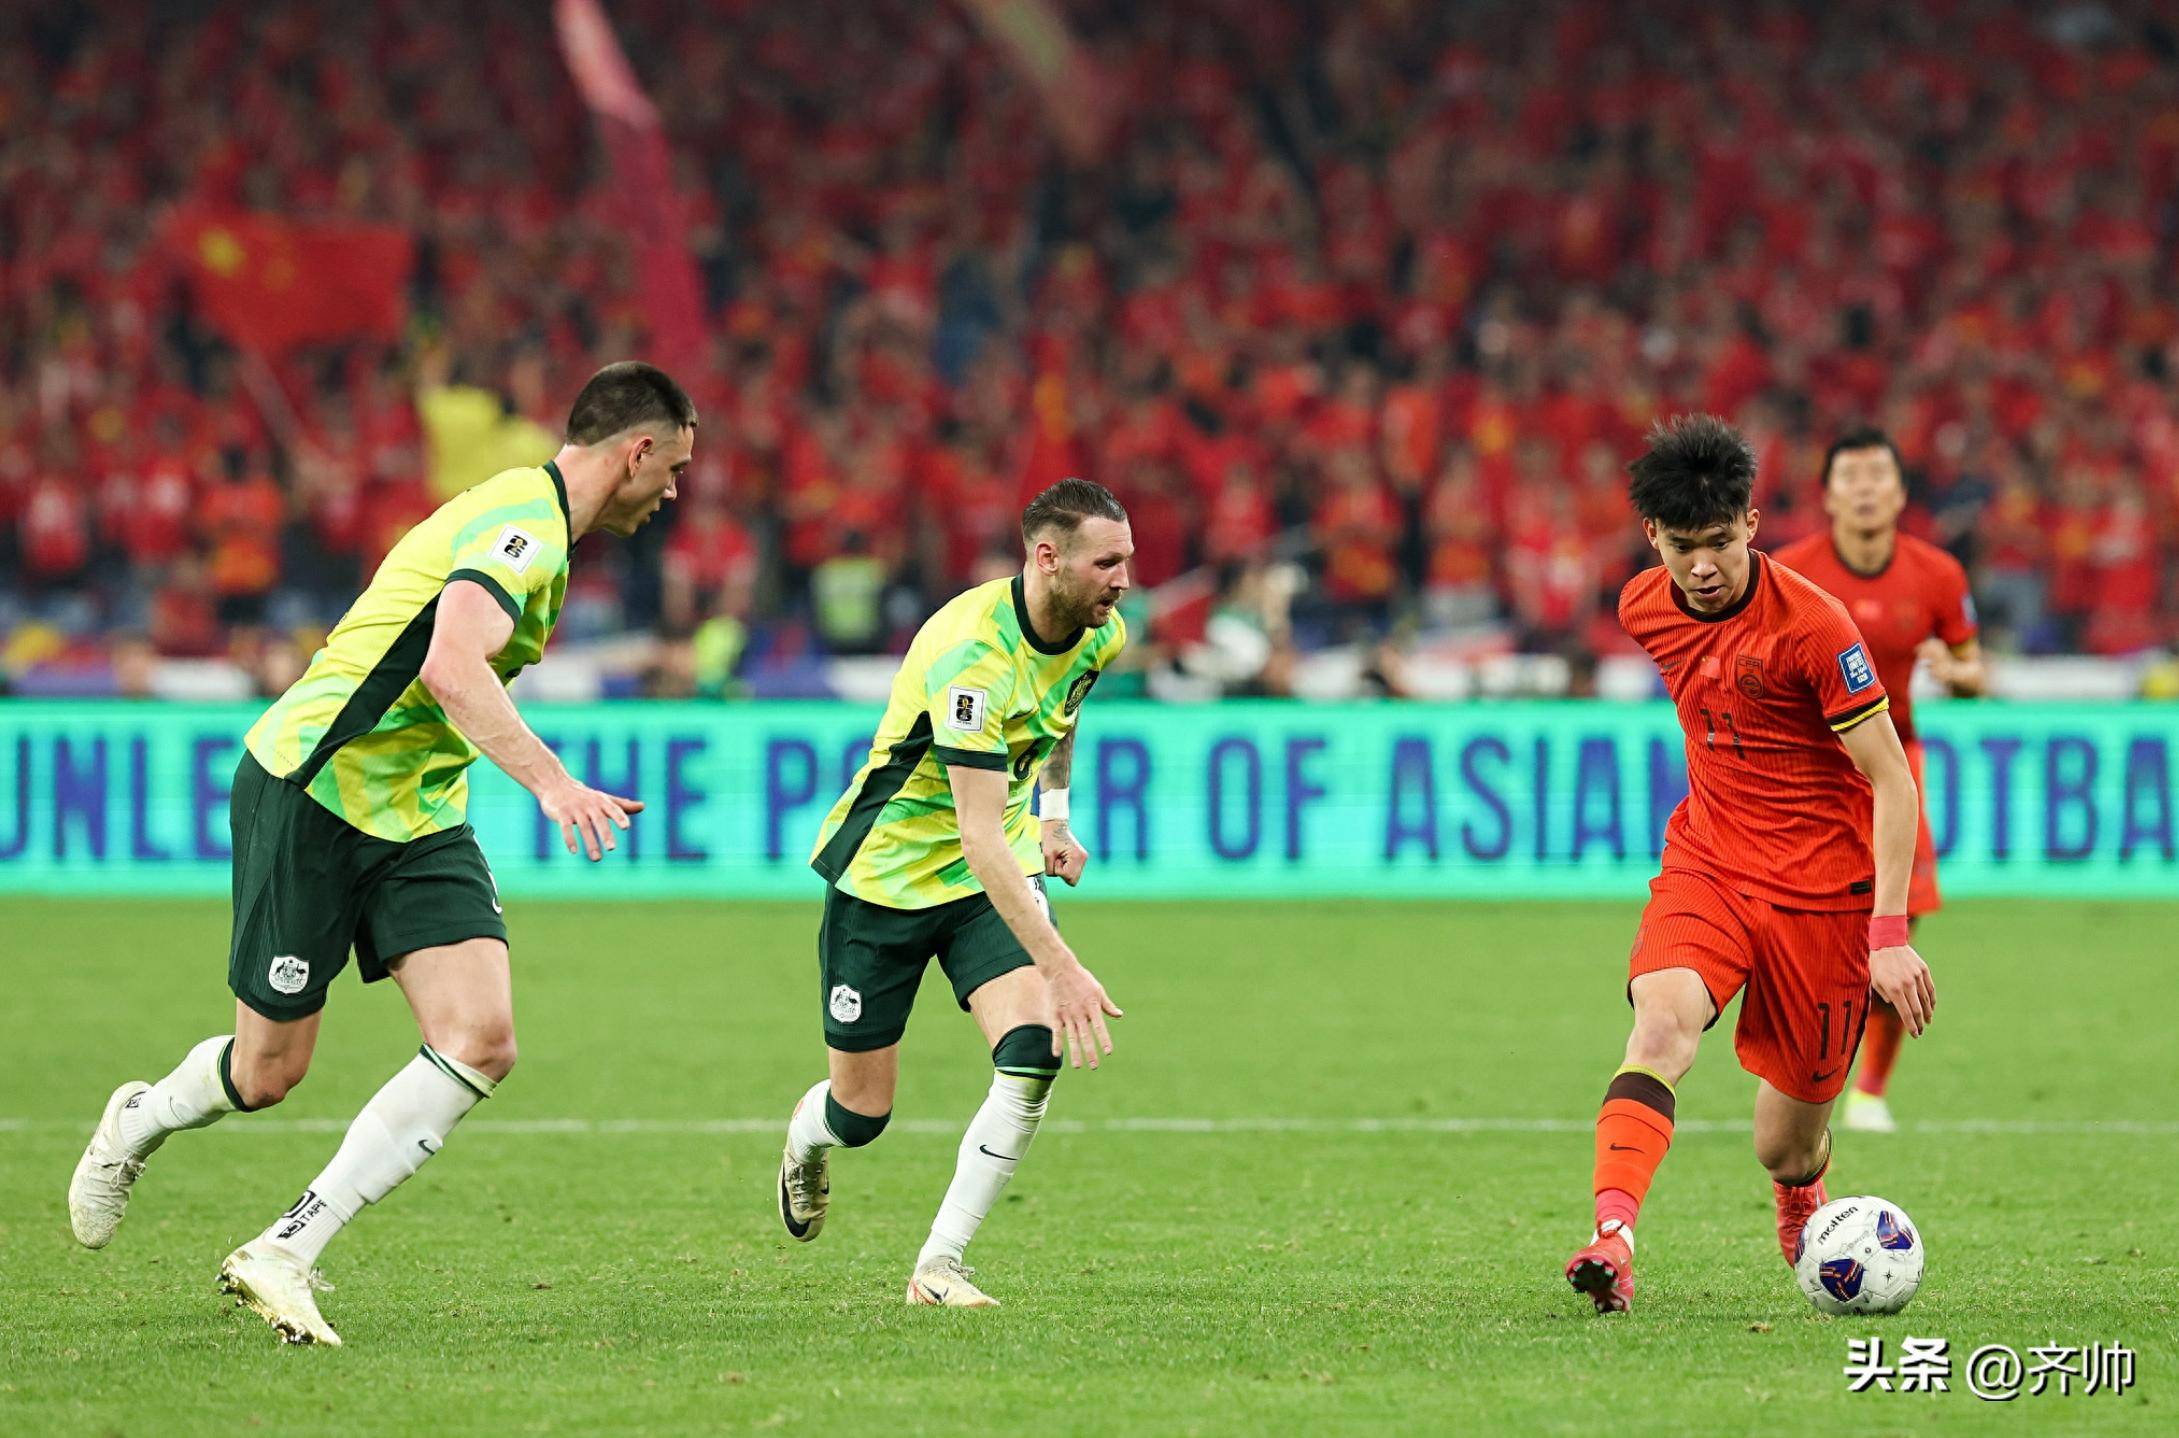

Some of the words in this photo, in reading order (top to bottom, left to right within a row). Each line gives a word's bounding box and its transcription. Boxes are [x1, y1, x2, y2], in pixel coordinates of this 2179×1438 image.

[1208, 738, 1328, 862] OF
[1817, 1000, 1852, 1060] 11
[1817, 1206, 1859, 1245] molten
